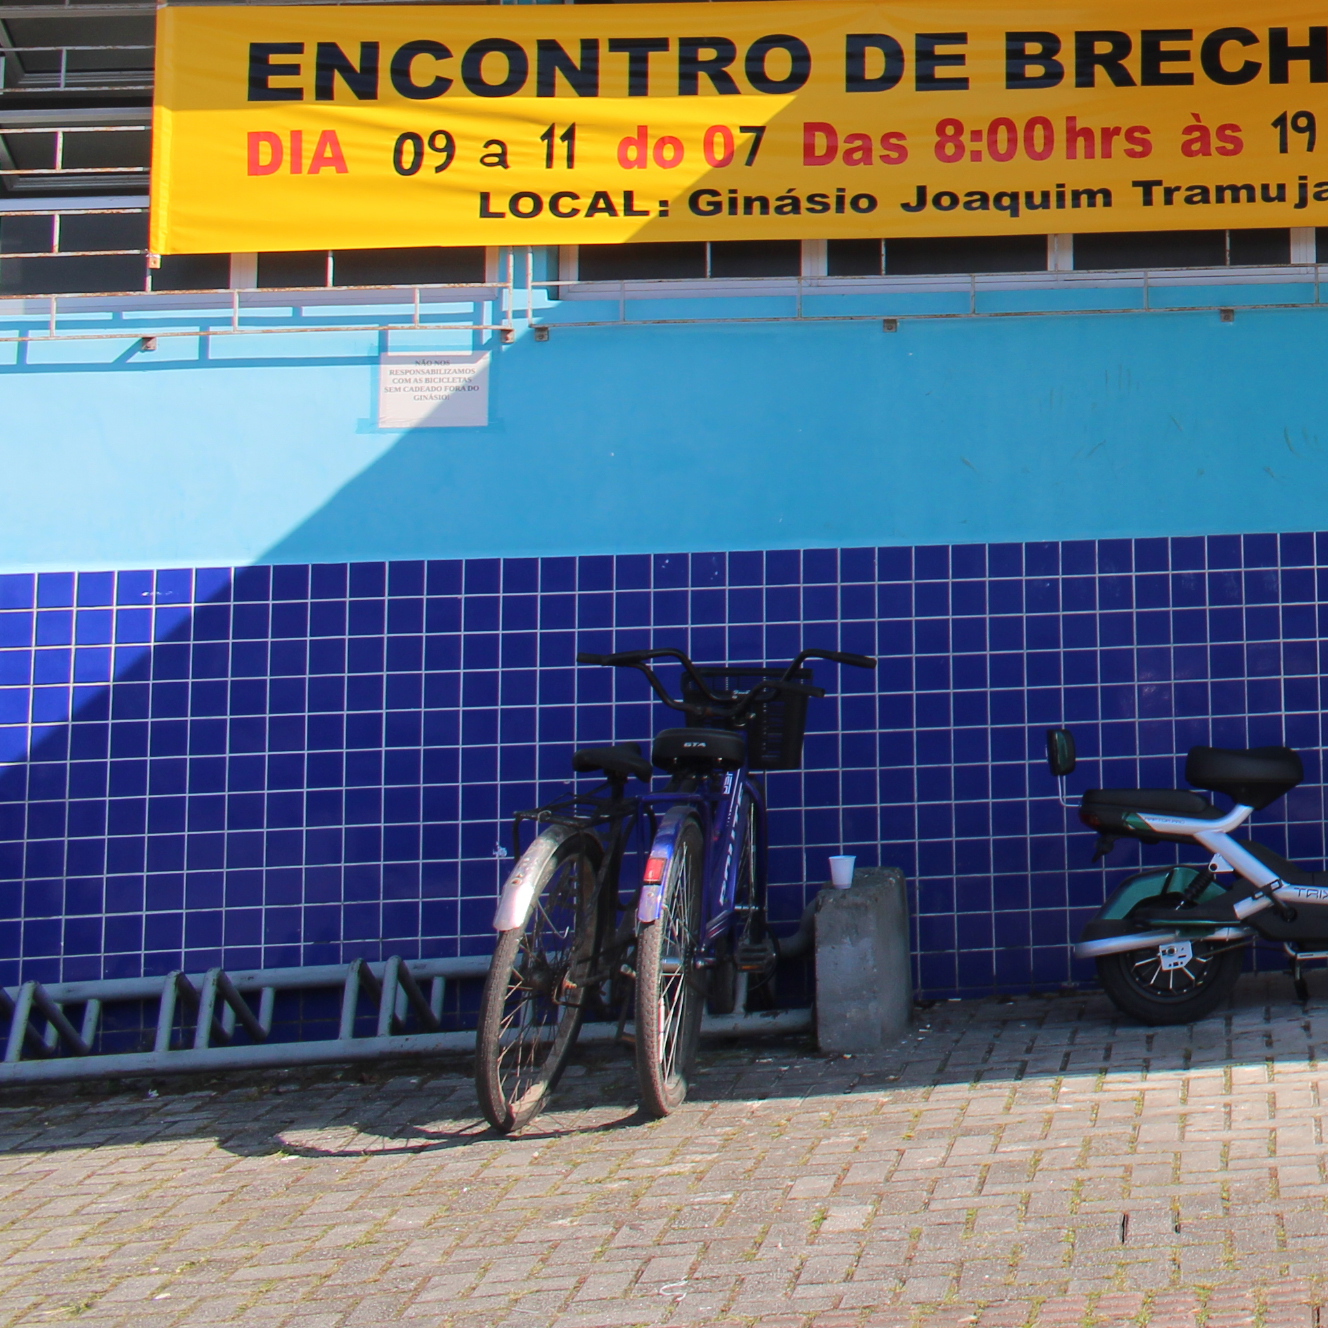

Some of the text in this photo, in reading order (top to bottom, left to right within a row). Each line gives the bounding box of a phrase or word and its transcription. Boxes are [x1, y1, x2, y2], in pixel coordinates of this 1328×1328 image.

[248, 33, 813, 102] ENCONTRO
[845, 31, 971, 93] DE
[248, 129, 348, 176] DIA
[394, 129, 456, 177] 09
[479, 138, 510, 169] a
[540, 122, 577, 169] 11
[617, 124, 685, 170] do
[702, 124, 768, 169] 07
[802, 121, 910, 167] Das
[1180, 111, 1245, 158] às
[479, 189, 671, 219] LOCAL:
[687, 187, 879, 217] Ginásio
[900, 183, 1113, 218] Joaquim
[415, 359, 450, 367] NÃO NOS
[389, 368, 476, 376] RESPONSABILIZAMOS
[425, 376, 473, 384] BICICLETAS
[403, 385, 443, 393] CADEADO
[467, 384, 480, 392] DO
